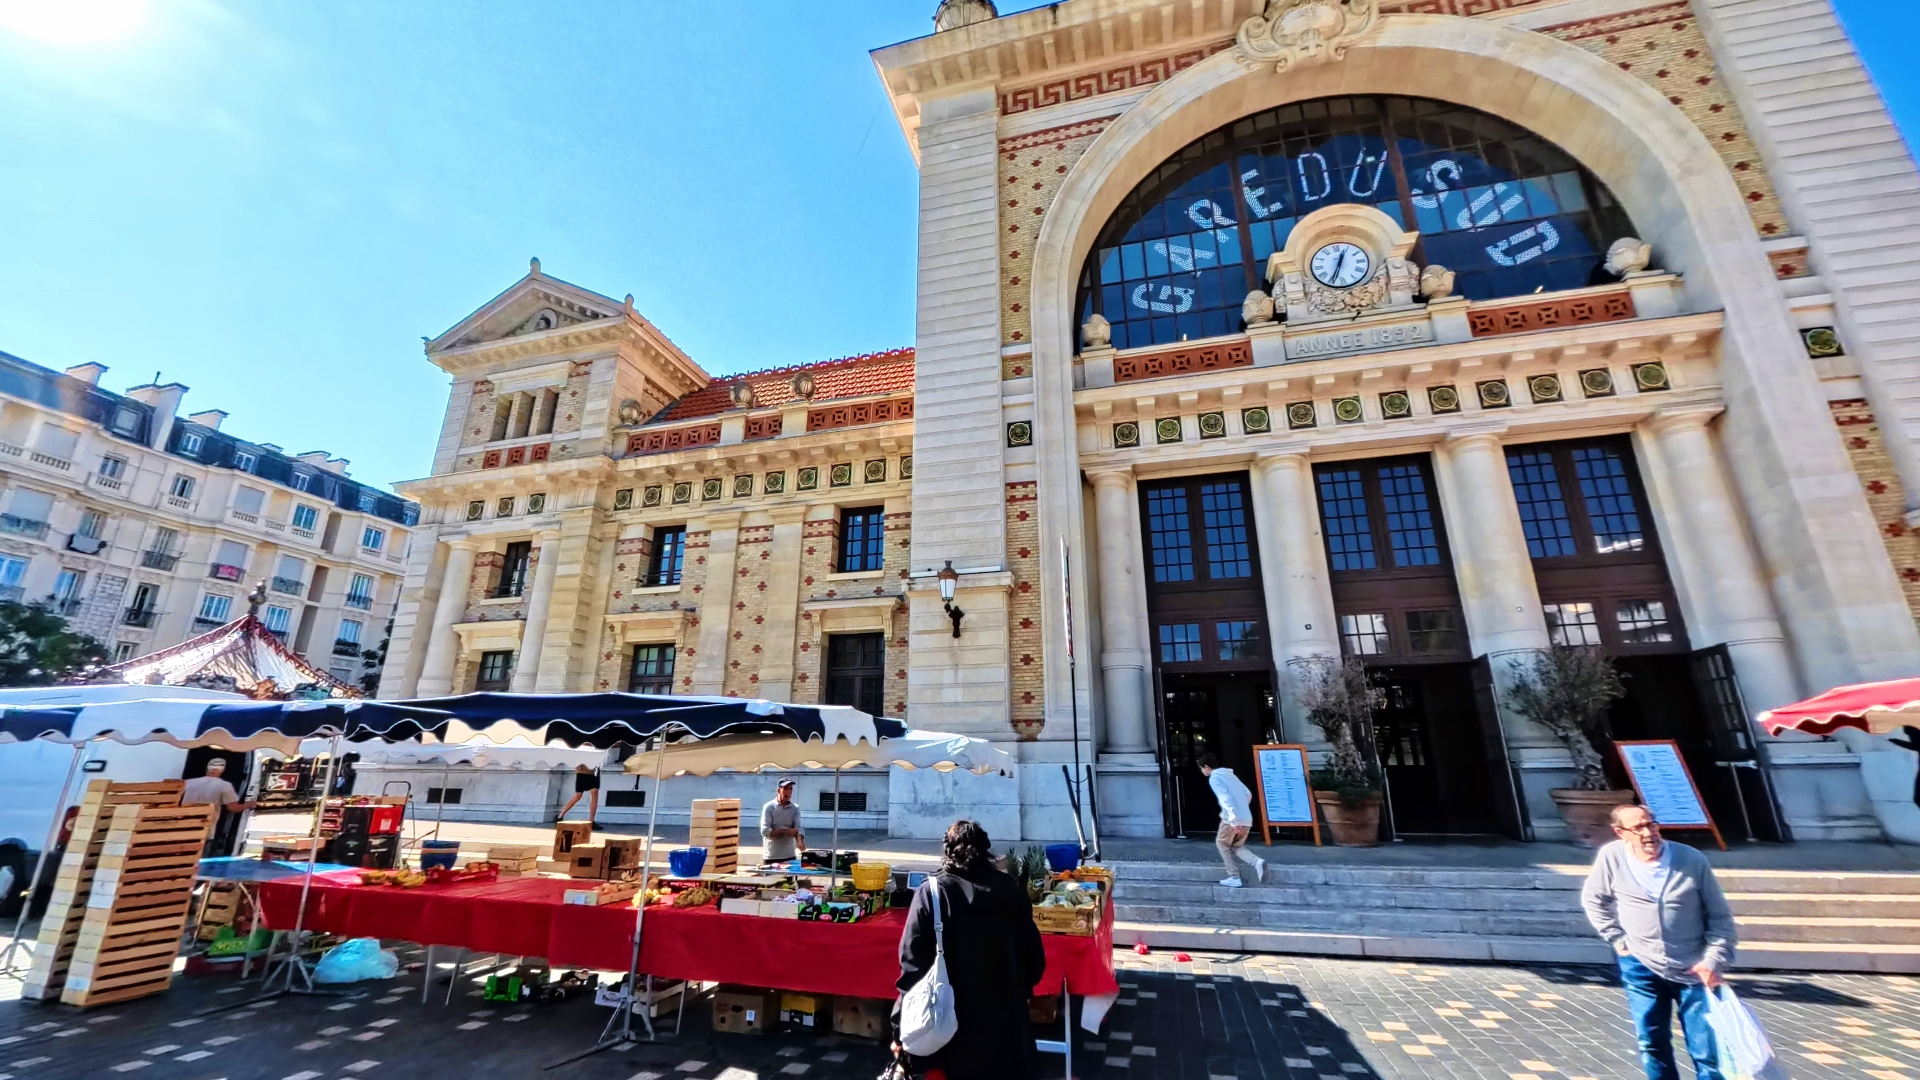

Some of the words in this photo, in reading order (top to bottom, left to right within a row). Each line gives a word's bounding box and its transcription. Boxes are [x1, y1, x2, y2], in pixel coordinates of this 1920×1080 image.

[1131, 168, 1283, 314] GARE
[1297, 148, 1388, 201] DU
[1411, 159, 1560, 267] SUD
[1371, 324, 1423, 344] 1892
